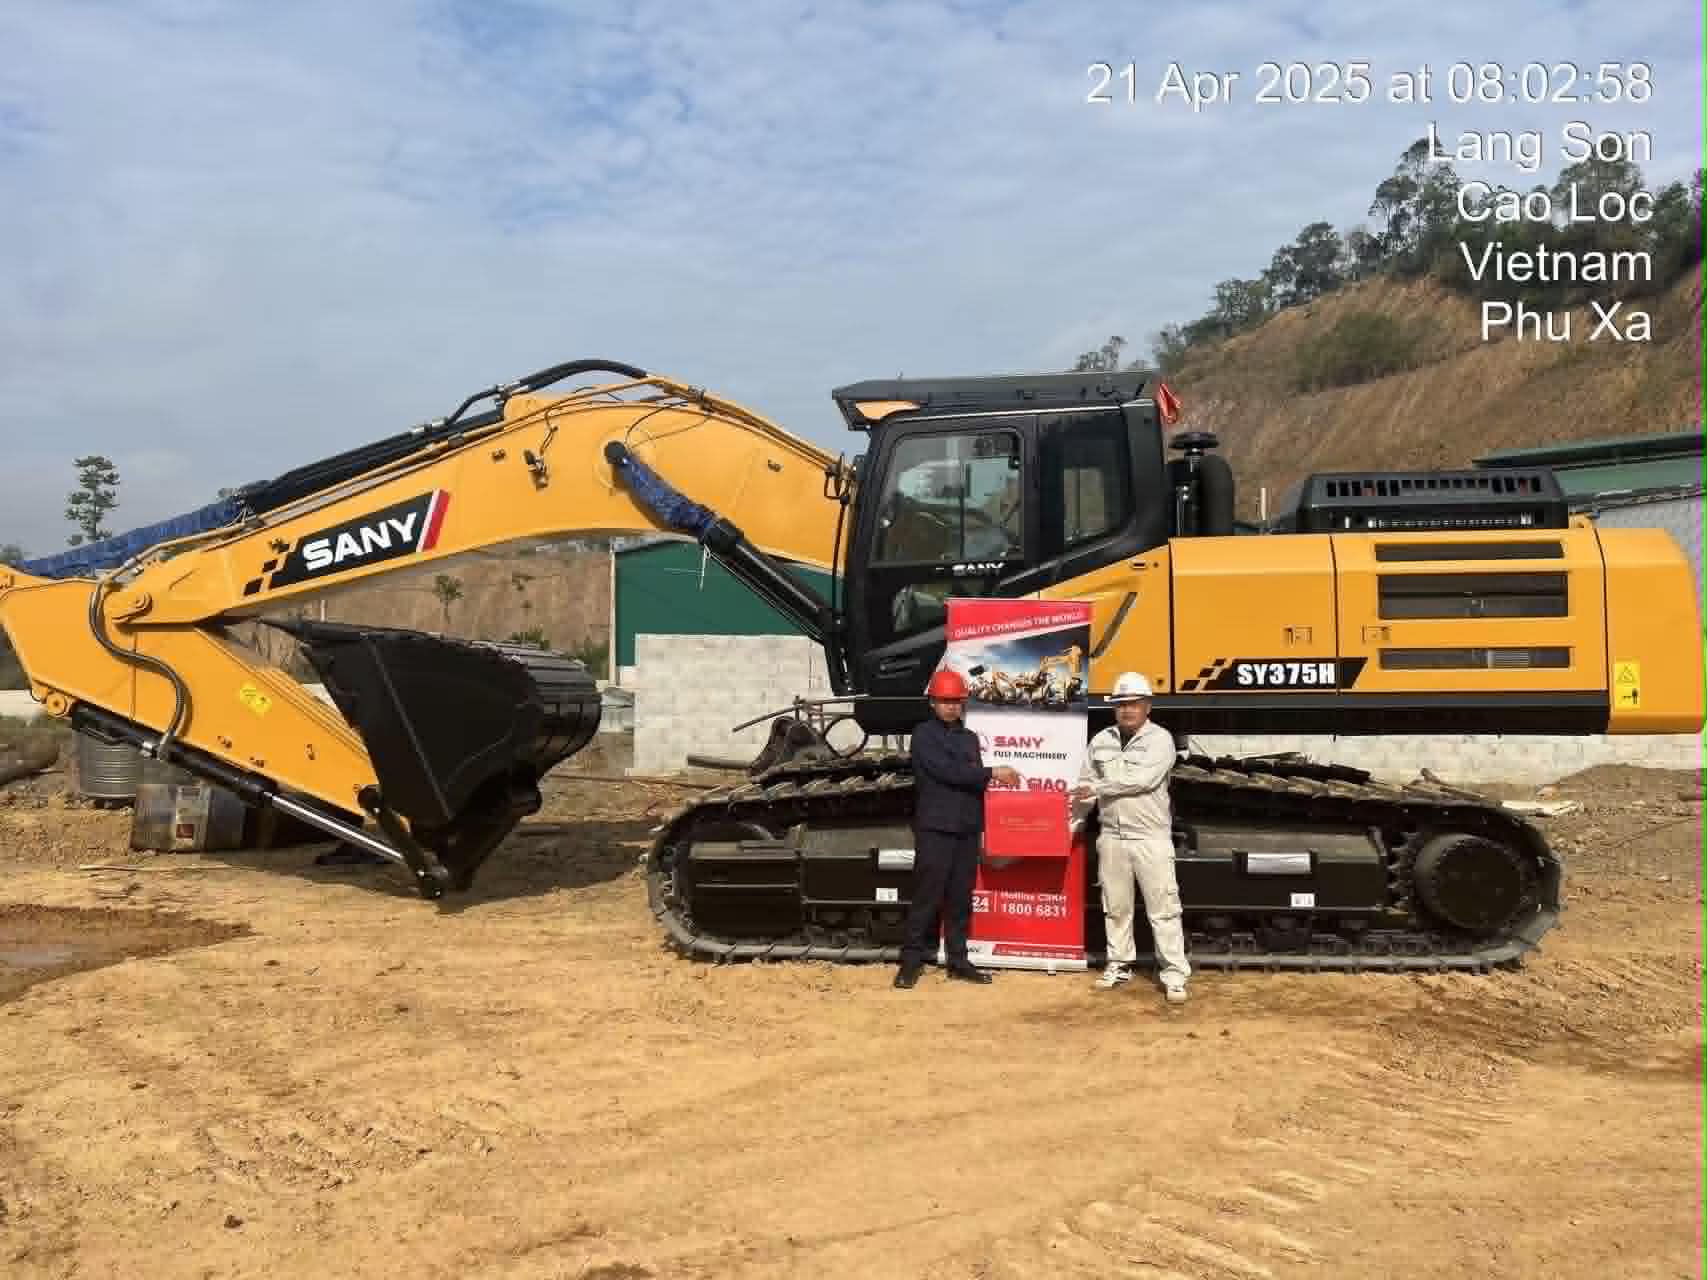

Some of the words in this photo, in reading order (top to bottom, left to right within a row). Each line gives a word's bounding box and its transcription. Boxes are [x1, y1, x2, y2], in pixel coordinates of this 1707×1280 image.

[302, 511, 417, 571] SANY
[992, 616, 1032, 632] CHANES
[1236, 663, 1336, 685] SY375H
[993, 735, 1045, 749] SANY
[971, 895, 989, 907] 24
[1001, 903, 1032, 915] 1800
[1036, 903, 1067, 918] 6831
